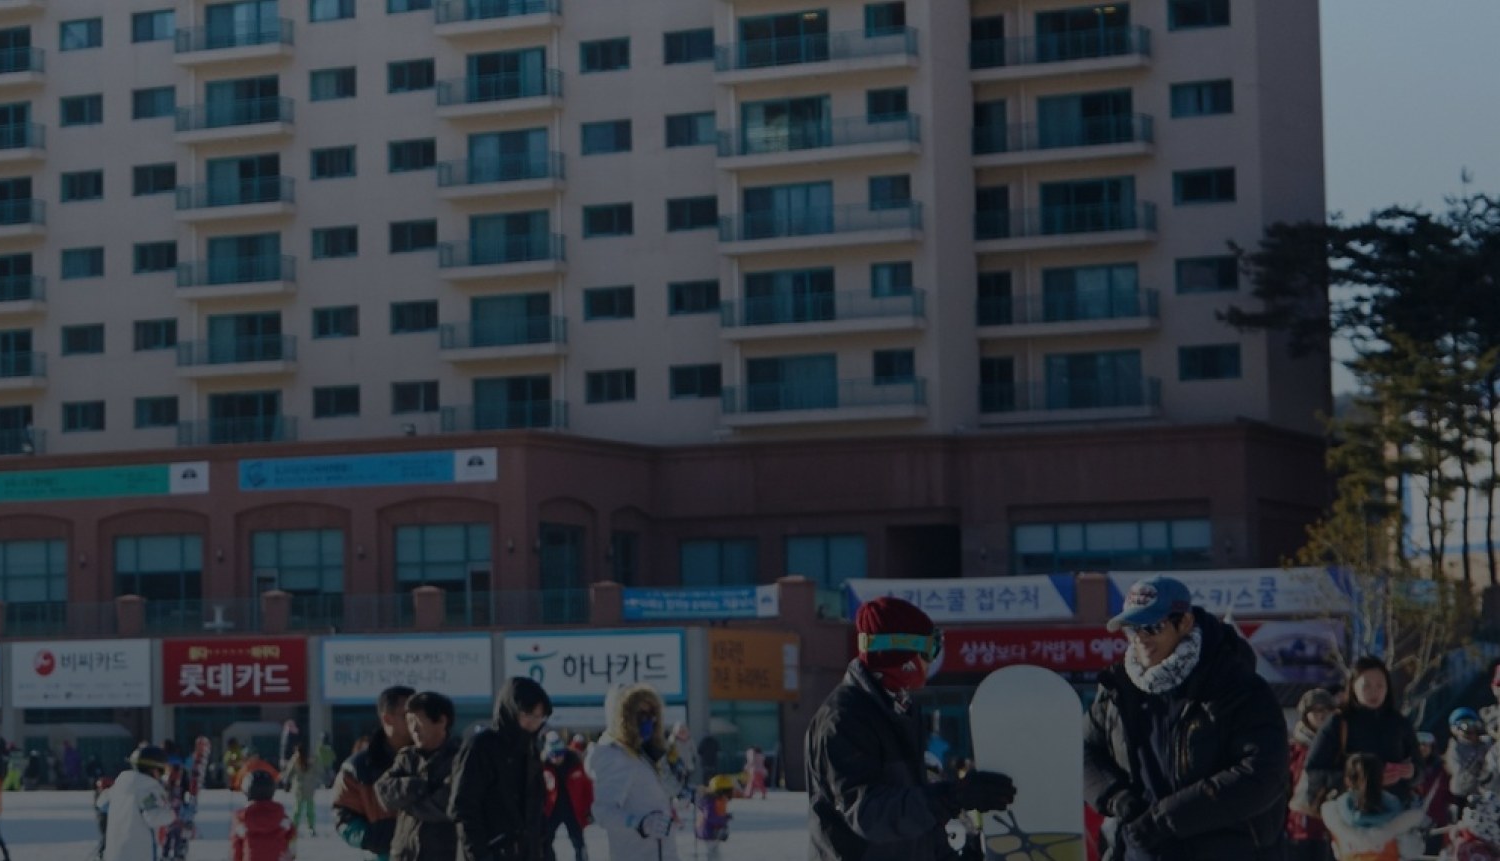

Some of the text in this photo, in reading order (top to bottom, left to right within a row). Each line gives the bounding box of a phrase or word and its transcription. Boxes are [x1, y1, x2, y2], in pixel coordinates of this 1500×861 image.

[976, 585, 1040, 612] 접수처
[61, 651, 129, 672] 비씨카드
[960, 640, 1027, 665] 상상보다
[179, 662, 292, 697] 롯데카드
[562, 652, 669, 685] 하나카드
